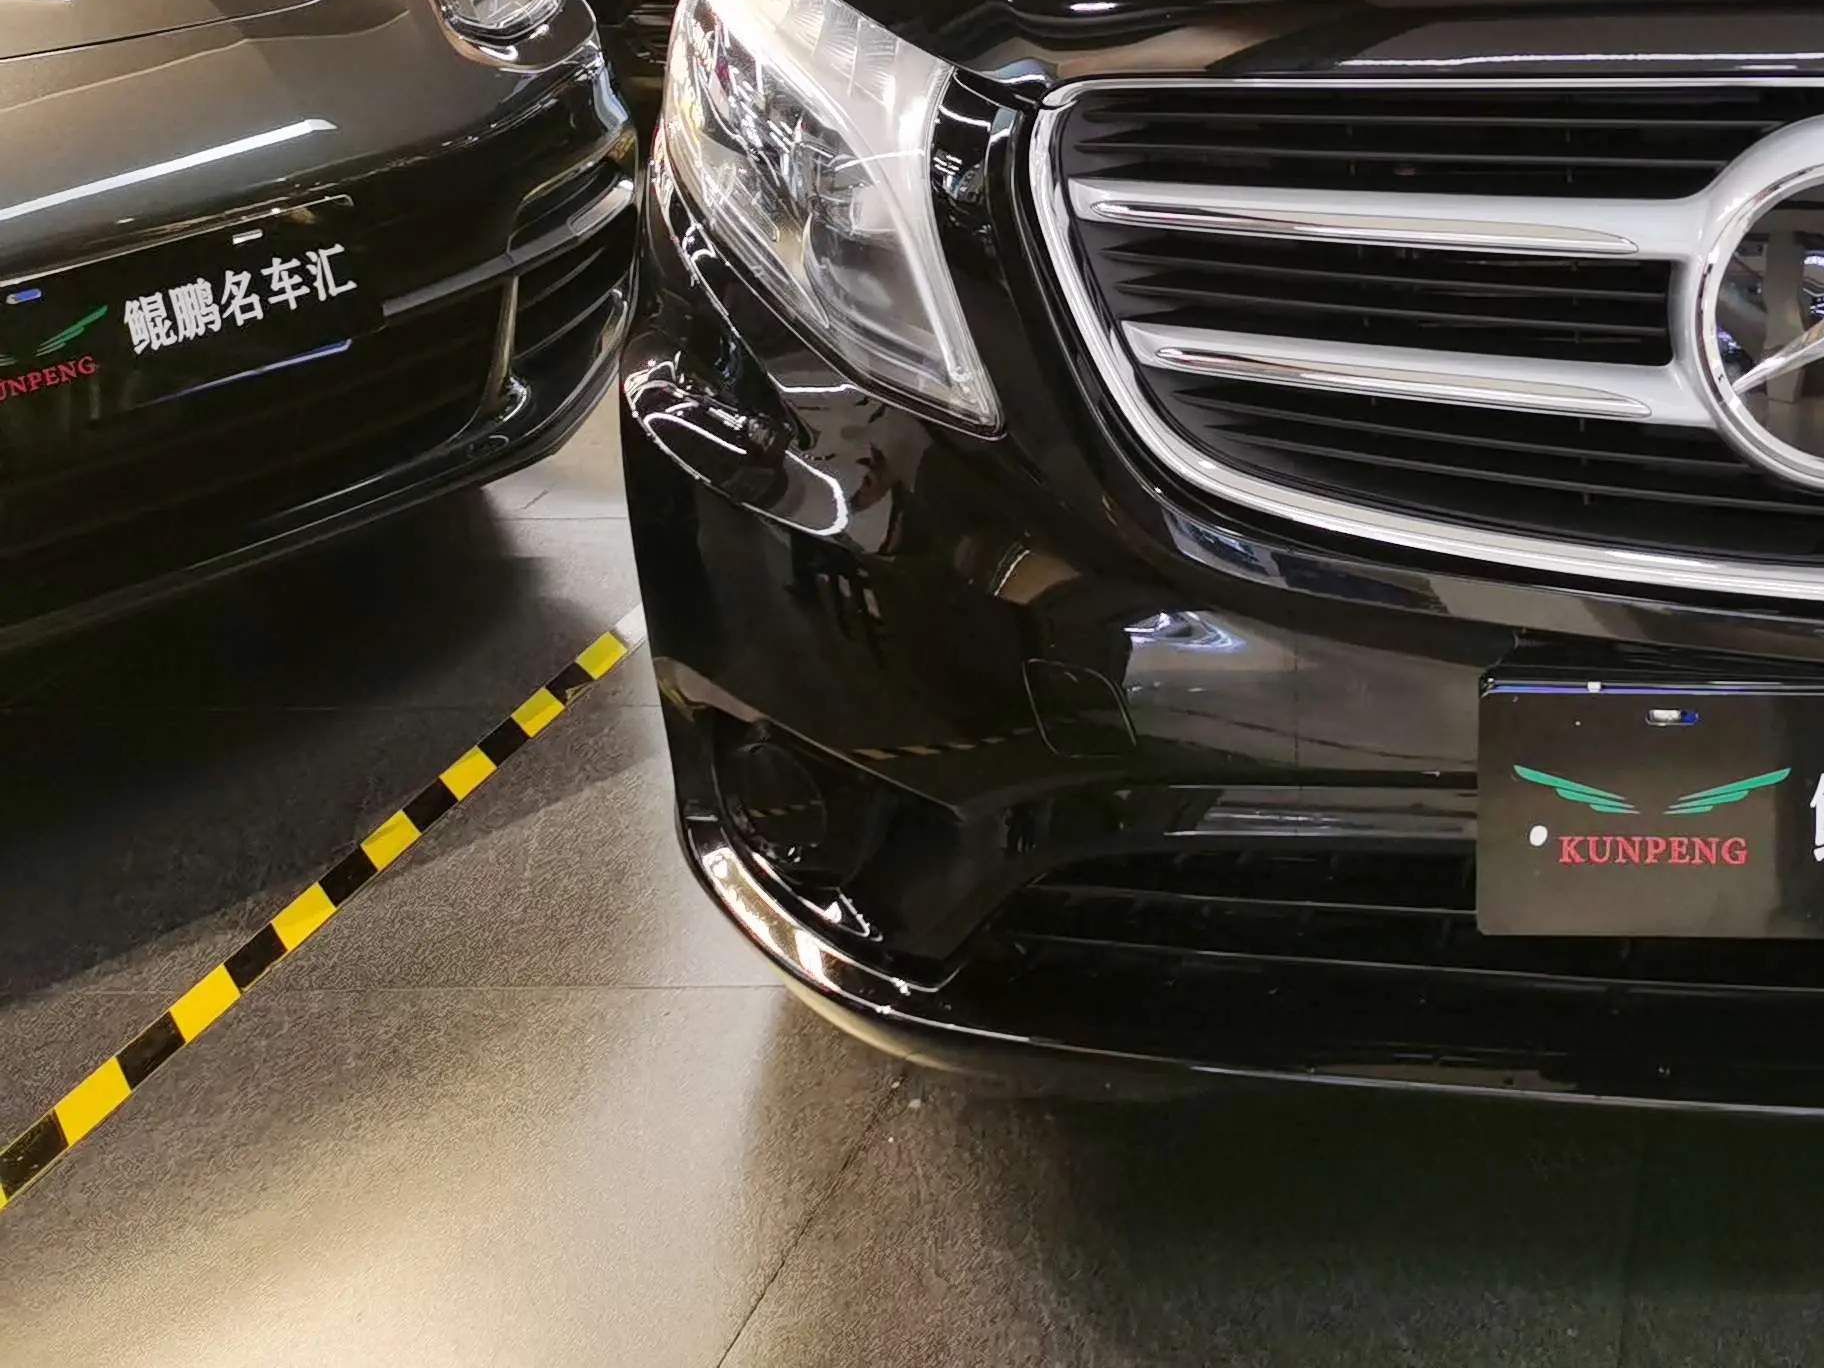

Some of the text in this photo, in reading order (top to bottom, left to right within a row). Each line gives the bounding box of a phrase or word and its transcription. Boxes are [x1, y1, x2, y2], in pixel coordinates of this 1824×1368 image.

[122, 244, 358, 355] 鲲鹏名车汇
[1558, 835, 1749, 865] KUNPENG
